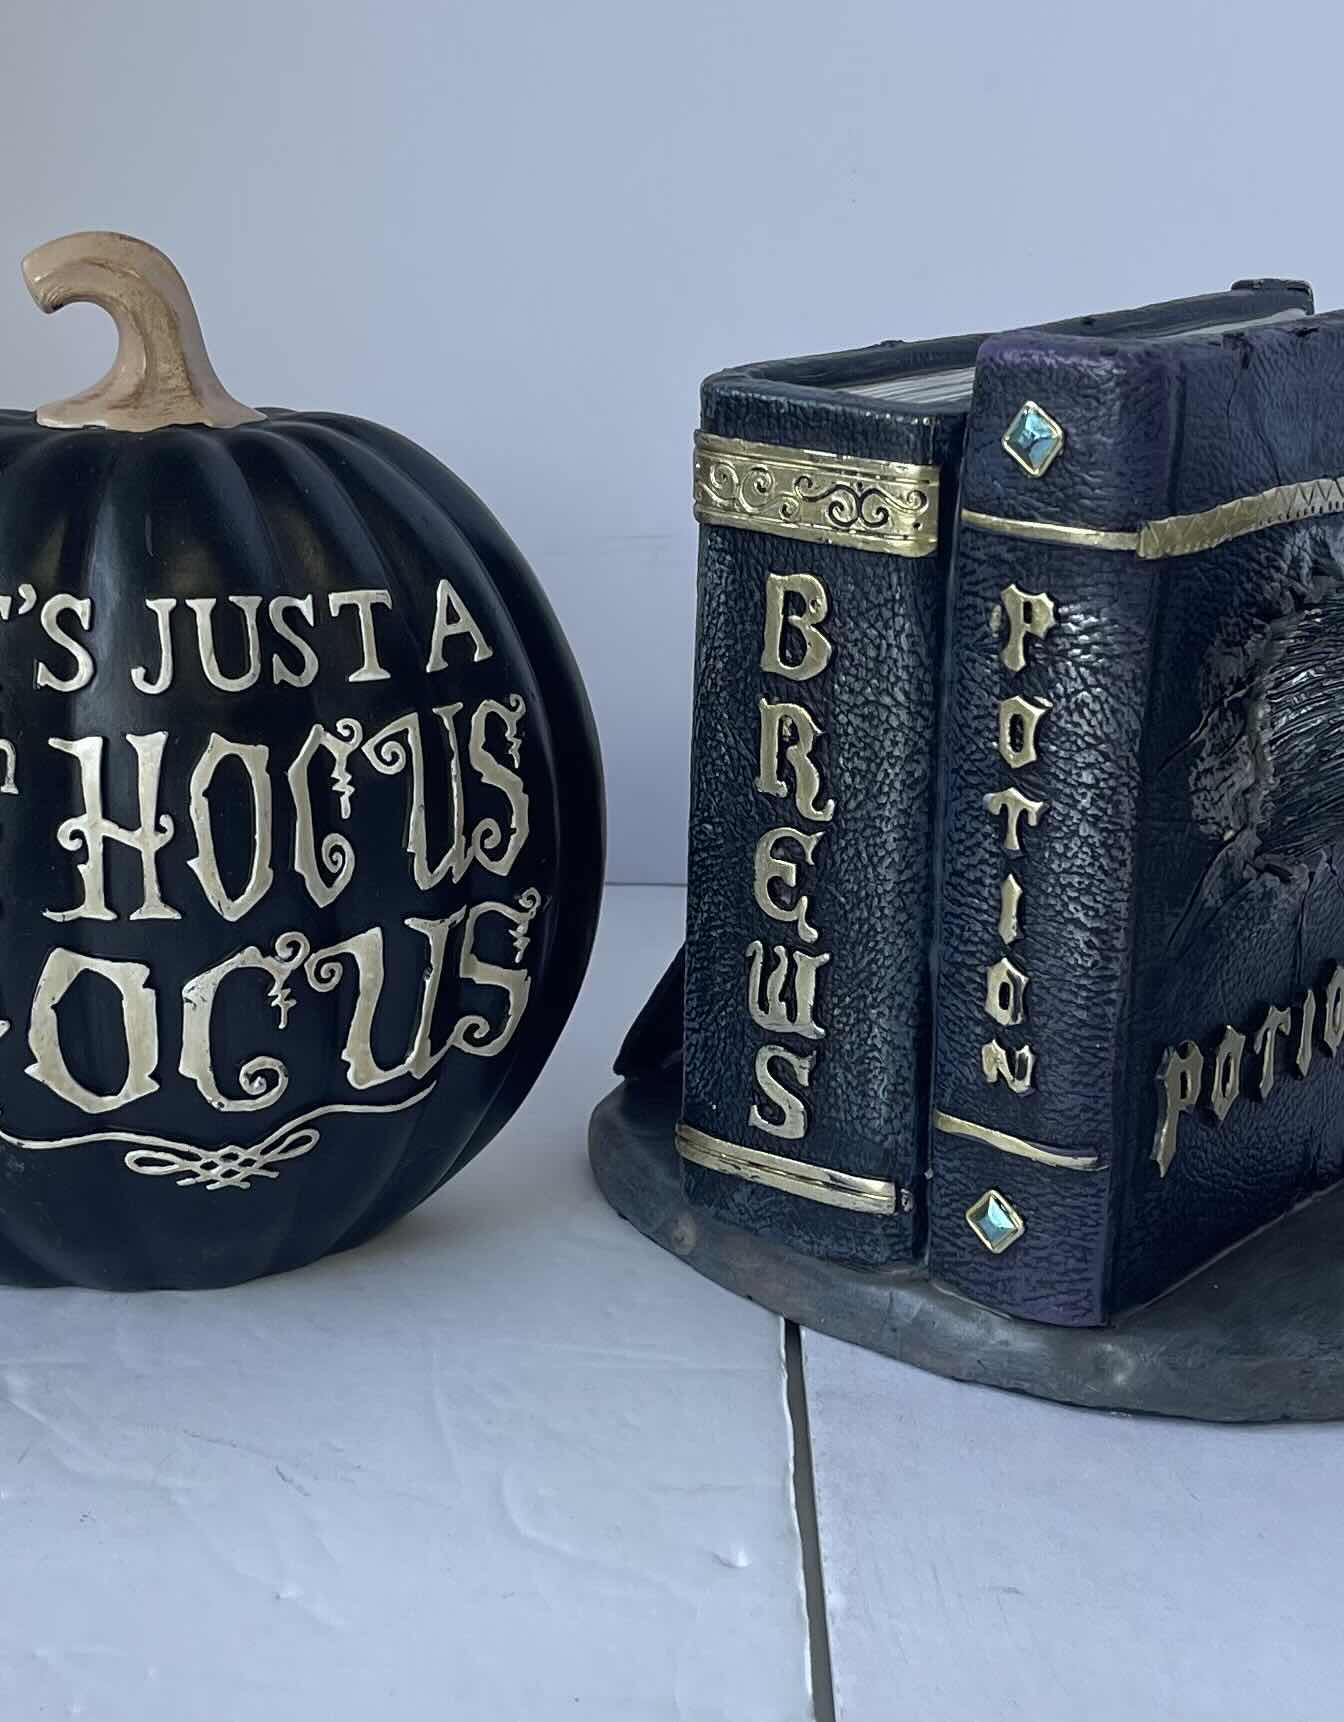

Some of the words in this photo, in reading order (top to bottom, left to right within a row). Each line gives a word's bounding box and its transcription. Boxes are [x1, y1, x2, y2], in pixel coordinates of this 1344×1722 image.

[43, 693, 532, 923] HOCUS
[131, 588, 393, 694] JUST
[425, 579, 494, 673] A
[746, 572, 834, 1141] BREWS
[982, 583, 1056, 1096] POTION
